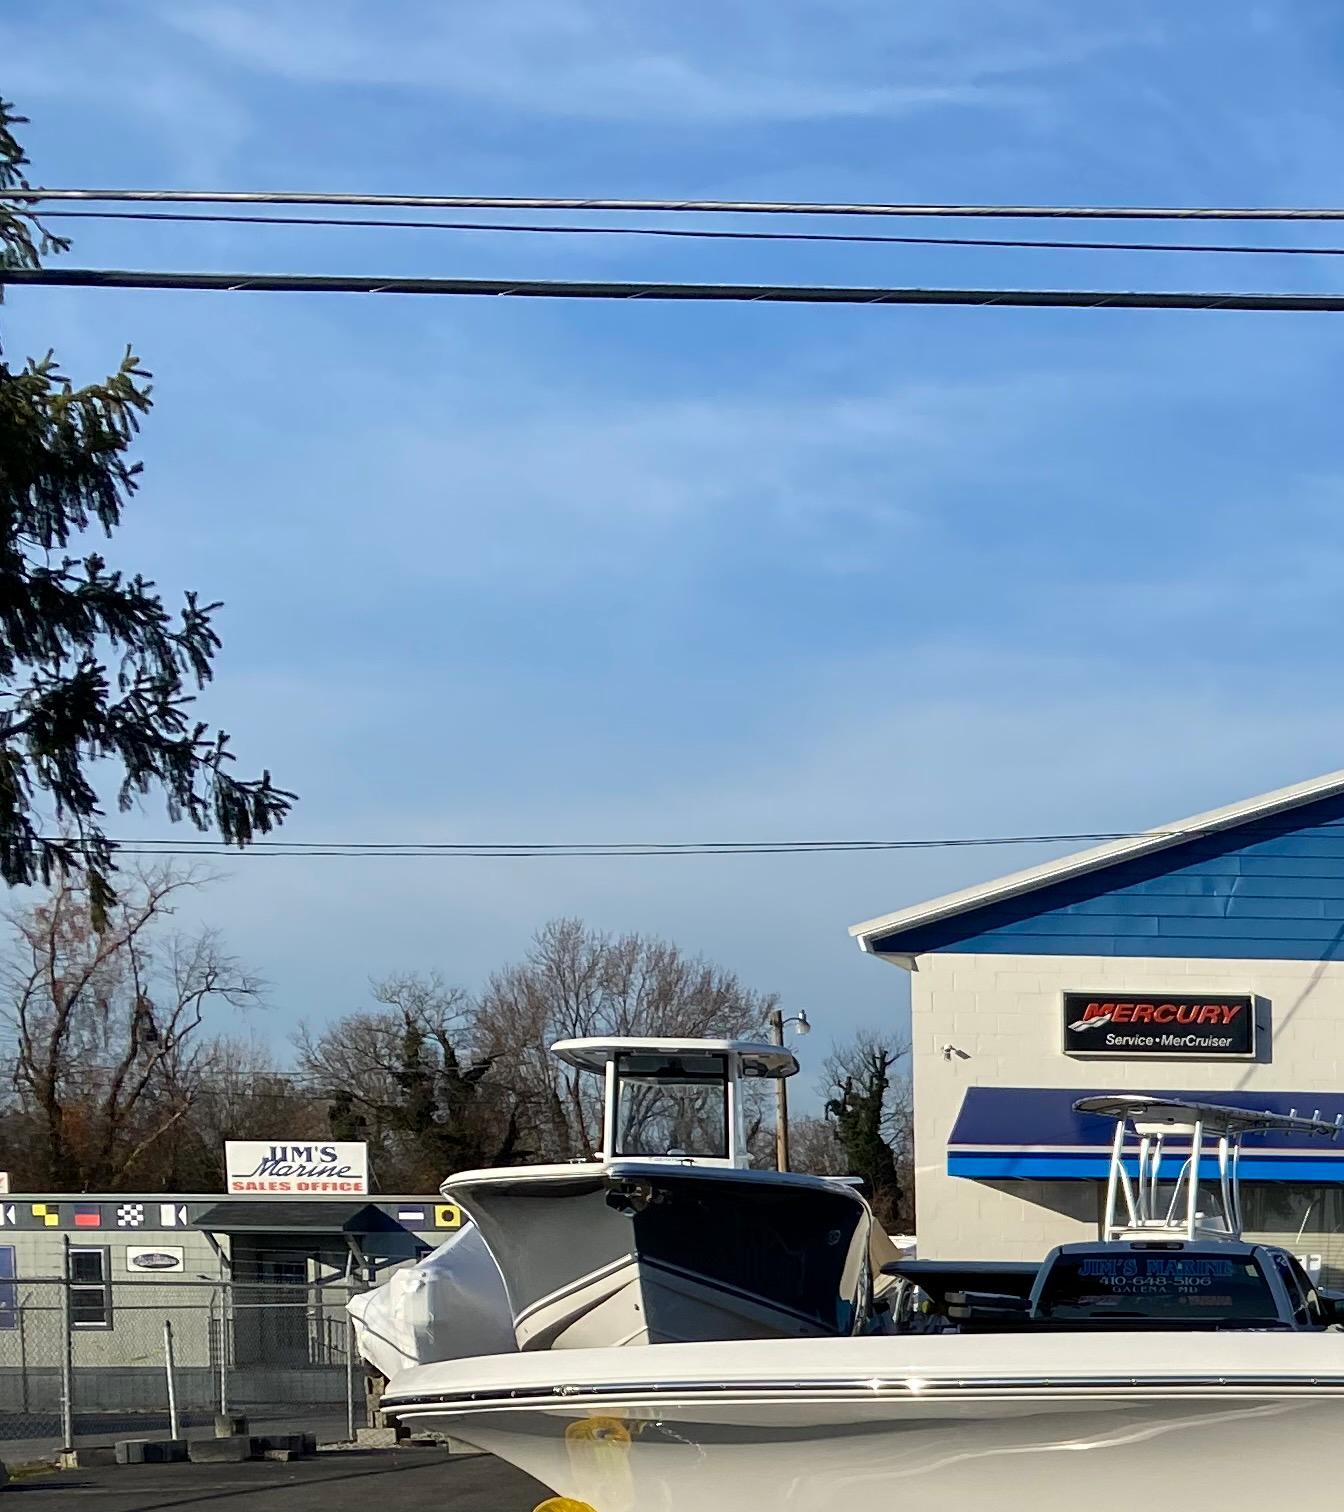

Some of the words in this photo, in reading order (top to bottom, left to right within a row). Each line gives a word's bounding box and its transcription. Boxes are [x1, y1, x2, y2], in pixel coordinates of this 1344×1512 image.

[1082, 1003, 1242, 1025] MERCURY
[262, 1146, 338, 1163] JIM'S
[249, 1158, 354, 1178] Marine
[232, 1181, 291, 1191] SALES
[297, 1182, 363, 1192] OFFICE
[1078, 1258, 1138, 1276] JIM'S
[1100, 1276, 1212, 1286] 410-648-5106
